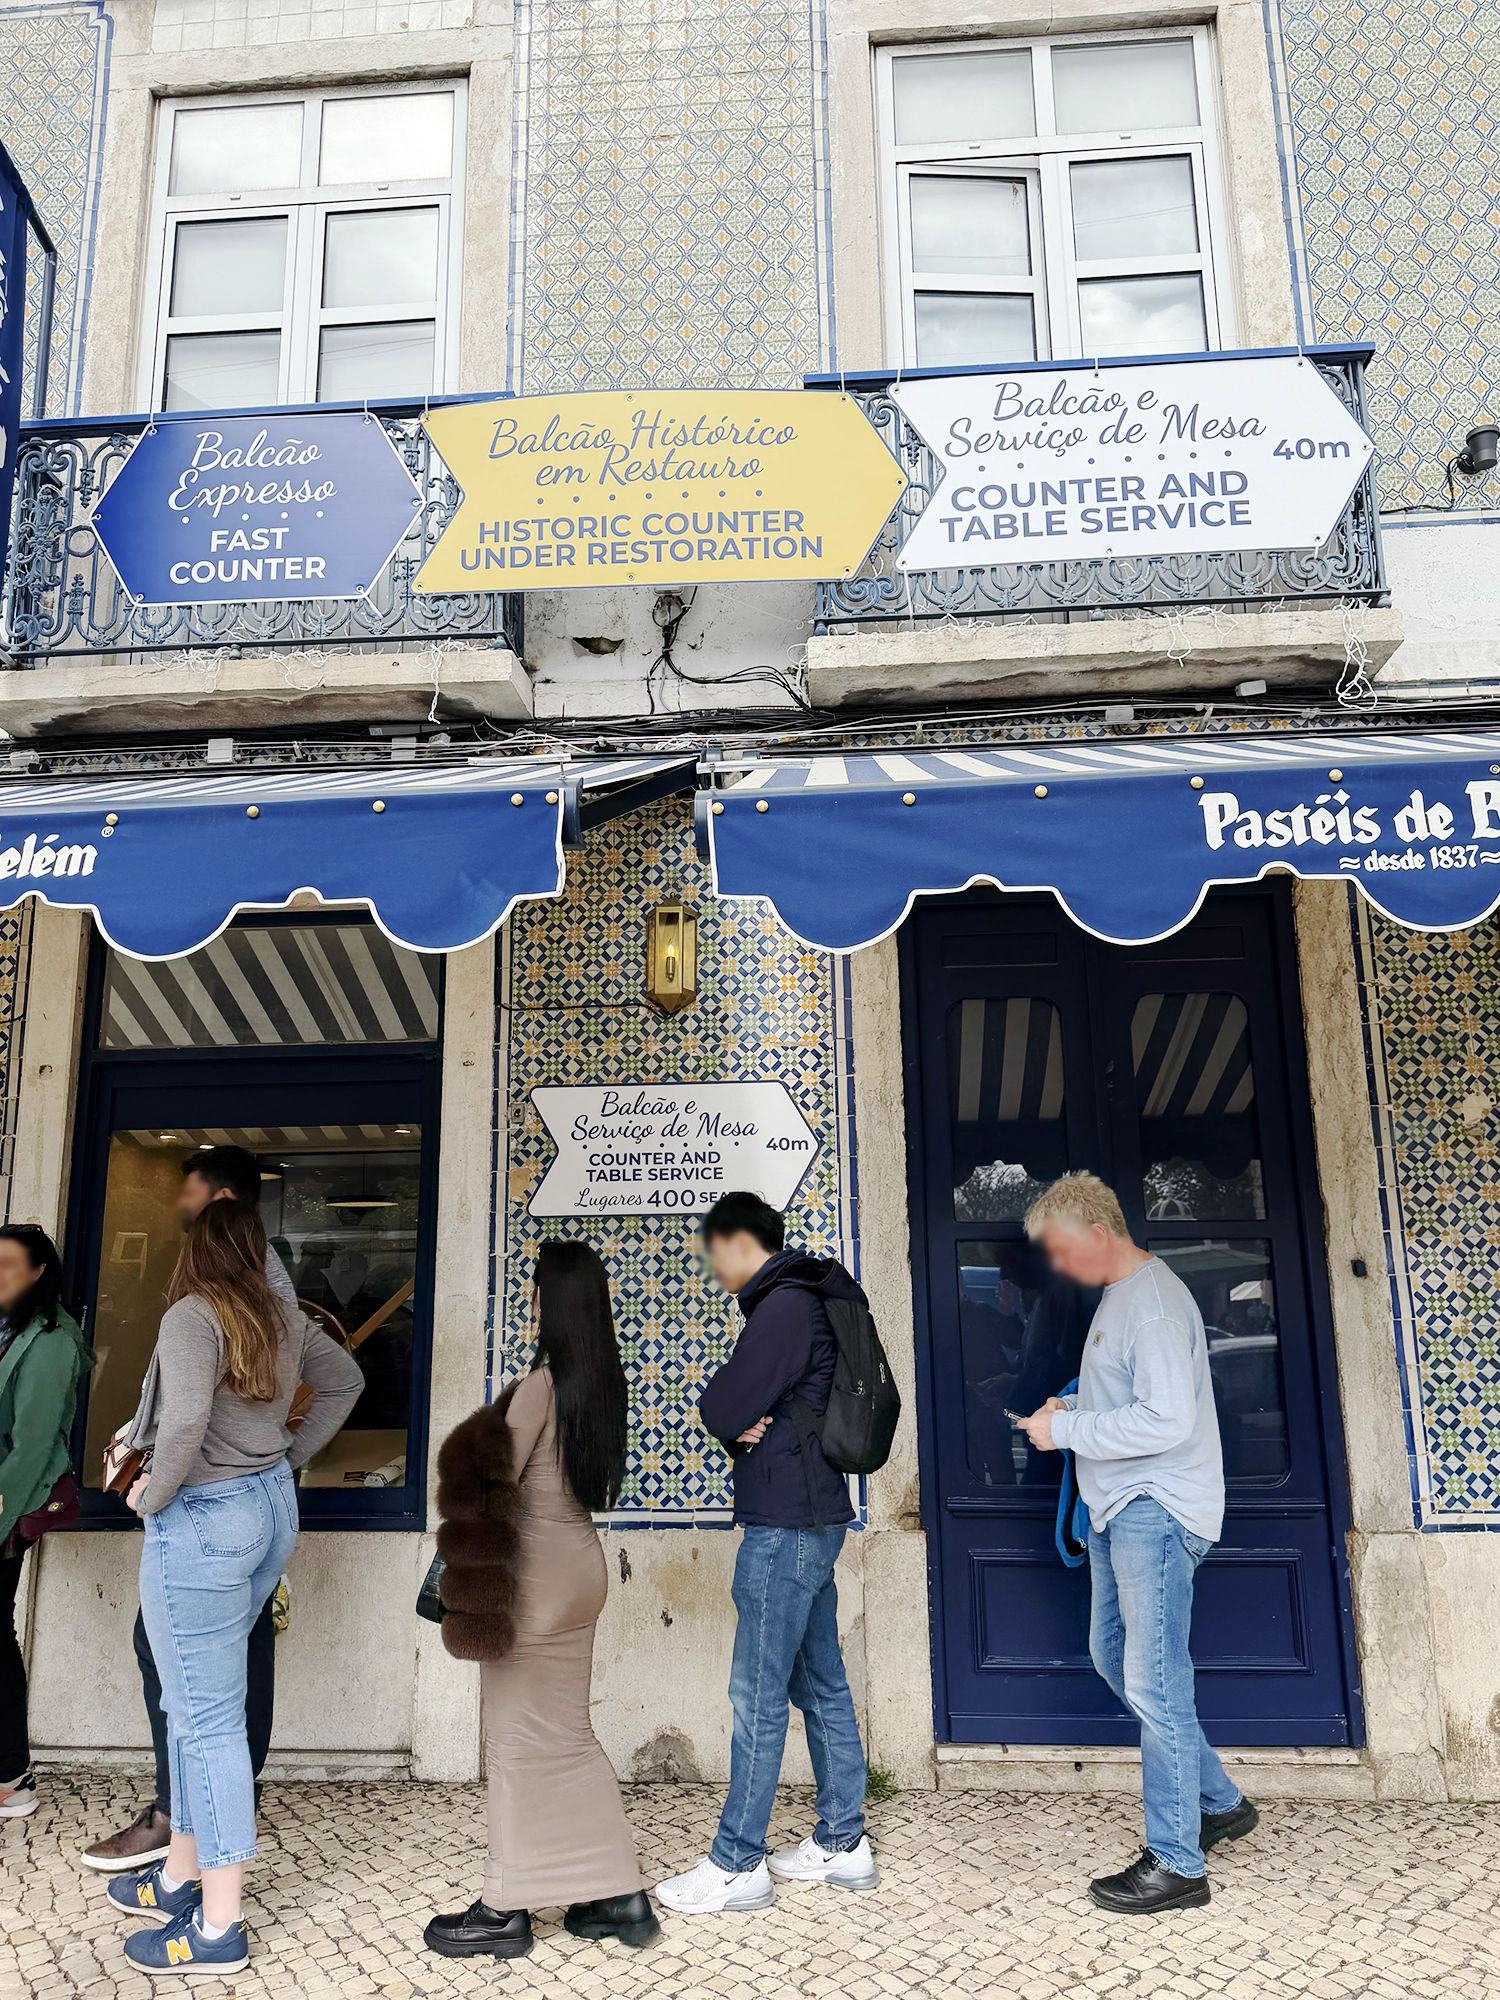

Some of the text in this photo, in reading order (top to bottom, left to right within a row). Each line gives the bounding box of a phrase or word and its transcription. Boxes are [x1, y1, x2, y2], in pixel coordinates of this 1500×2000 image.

[993, 379, 1159, 421] Balcão e
[488, 408, 799, 460] Balcão Histórico
[944, 403, 1267, 459] Serviço de Mesa
[190, 428, 323, 472] Balcão
[535, 443, 765, 487] em Restauro
[1272, 437, 1352, 462] 40m
[167, 467, 339, 519] Expresso
[950, 470, 1249, 513] COUNTER AND
[210, 526, 290, 552] FAST
[478, 509, 806, 545] HISTORIC COUNTER
[939, 499, 1253, 543] TABLE SERVICE
[169, 556, 326, 585] COUNTER
[460, 535, 824, 571] UNDER RESTORATION
[1198, 788, 1382, 850] Pastéis
[1393, 789, 1455, 843] de
[0, 832, 98, 880] elém
[1363, 844, 1480, 873] desde 1837
[600, 1091, 698, 1117] Balcão e
[570, 1112, 760, 1144] Serviço de Mesa
[765, 1137, 809, 1151] 40m
[585, 1167, 724, 1182] TABLE SERVICE
[588, 1151, 722, 1167] COUNTER AND
[573, 1187, 645, 1211] Lugares
[646, 1190, 696, 1208] 400
[166, 1936, 193, 1965] N
